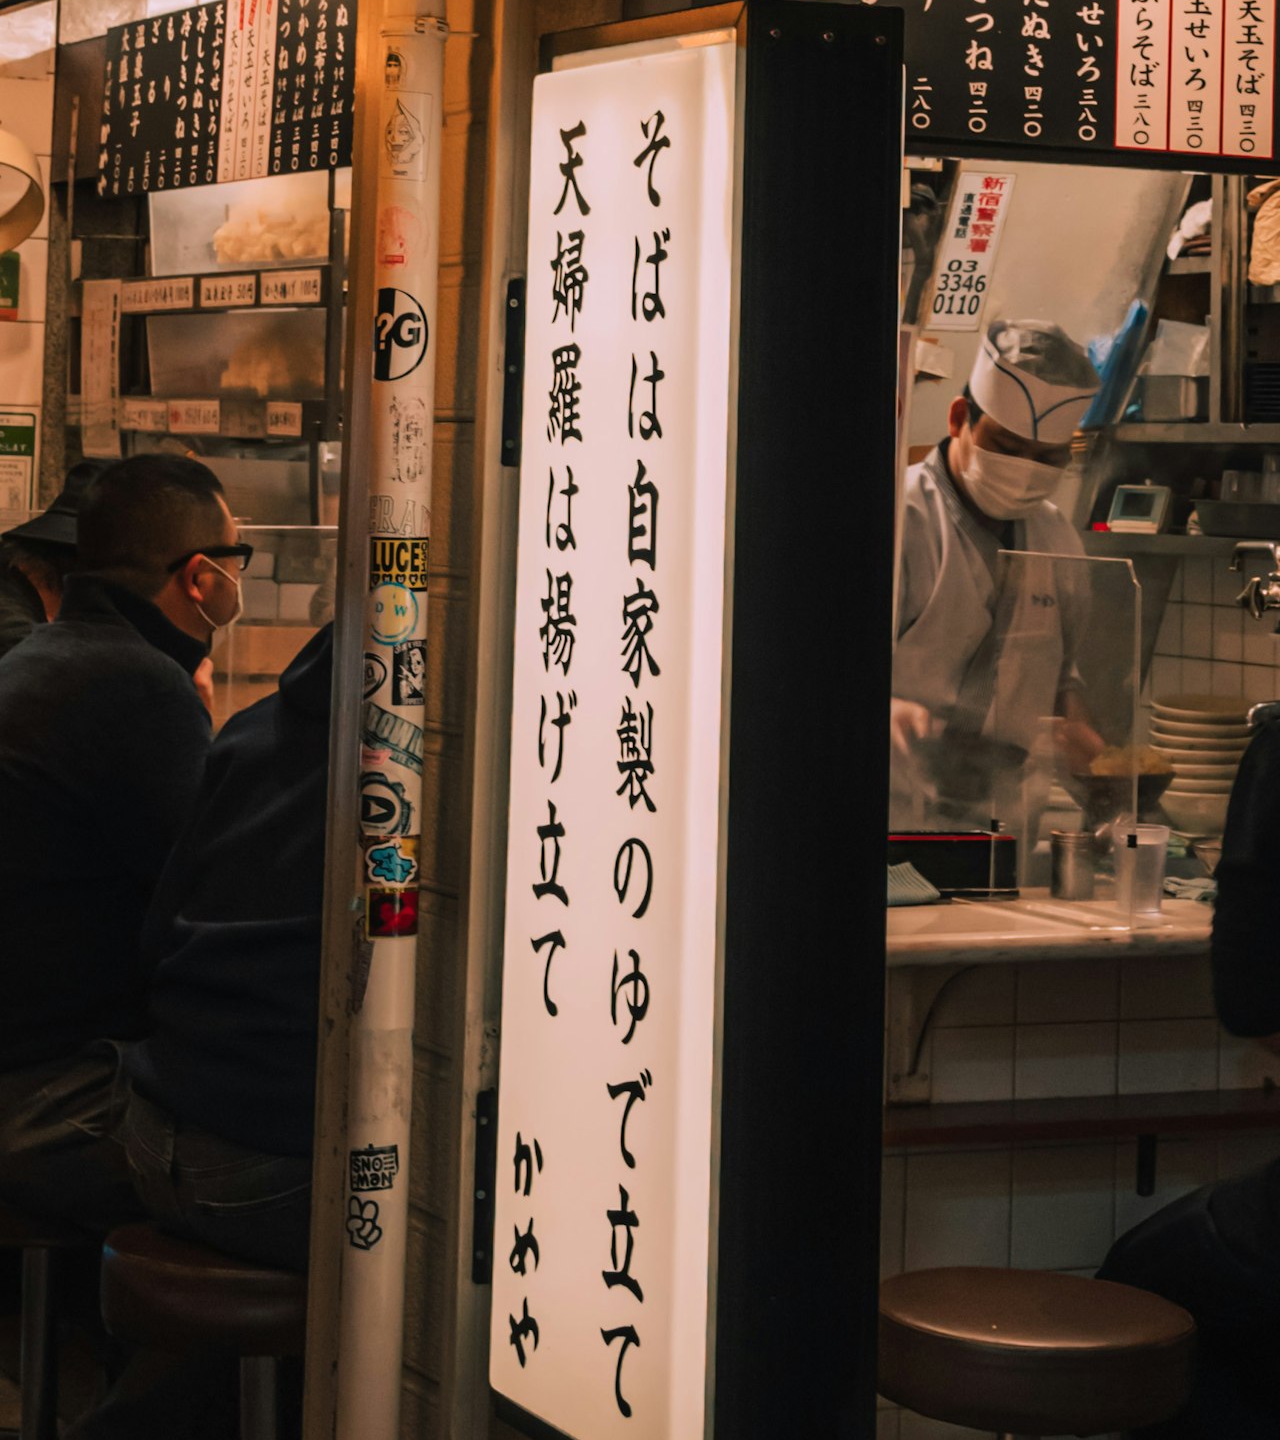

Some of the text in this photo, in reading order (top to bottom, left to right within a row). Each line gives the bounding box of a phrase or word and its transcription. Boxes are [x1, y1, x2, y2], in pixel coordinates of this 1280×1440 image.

[175, 10, 193, 140] 冷しきつね
[192, 7, 209, 139] 冷したぬき
[207, 3, 224, 137] 天ぷらせいろ
[911, 76, 933, 130] 二八〇
[968, 80, 988, 134] 四二〇
[1023, 85, 1043, 138] 四二〇
[1077, 88, 1098, 142] 三八〇
[1132, 93, 1151, 146] 三八〇
[1186, 99, 1204, 150] 四三〇
[1238, 103, 1256, 154] 四三〇
[954, 192, 976, 239] 直通電話
[966, 176, 1008, 253] 新宿警察署
[937, 273, 987, 294] 3346
[947, 259, 979, 273] 03
[932, 293, 981, 316] 0110
[371, 541, 420, 573] LUCE
[528, 116, 592, 1022] 天婦羅は揚げ立て
[597, 107, 672, 1426] そばは自家製のゆで立て
[506, 1129, 547, 1375] かめや
